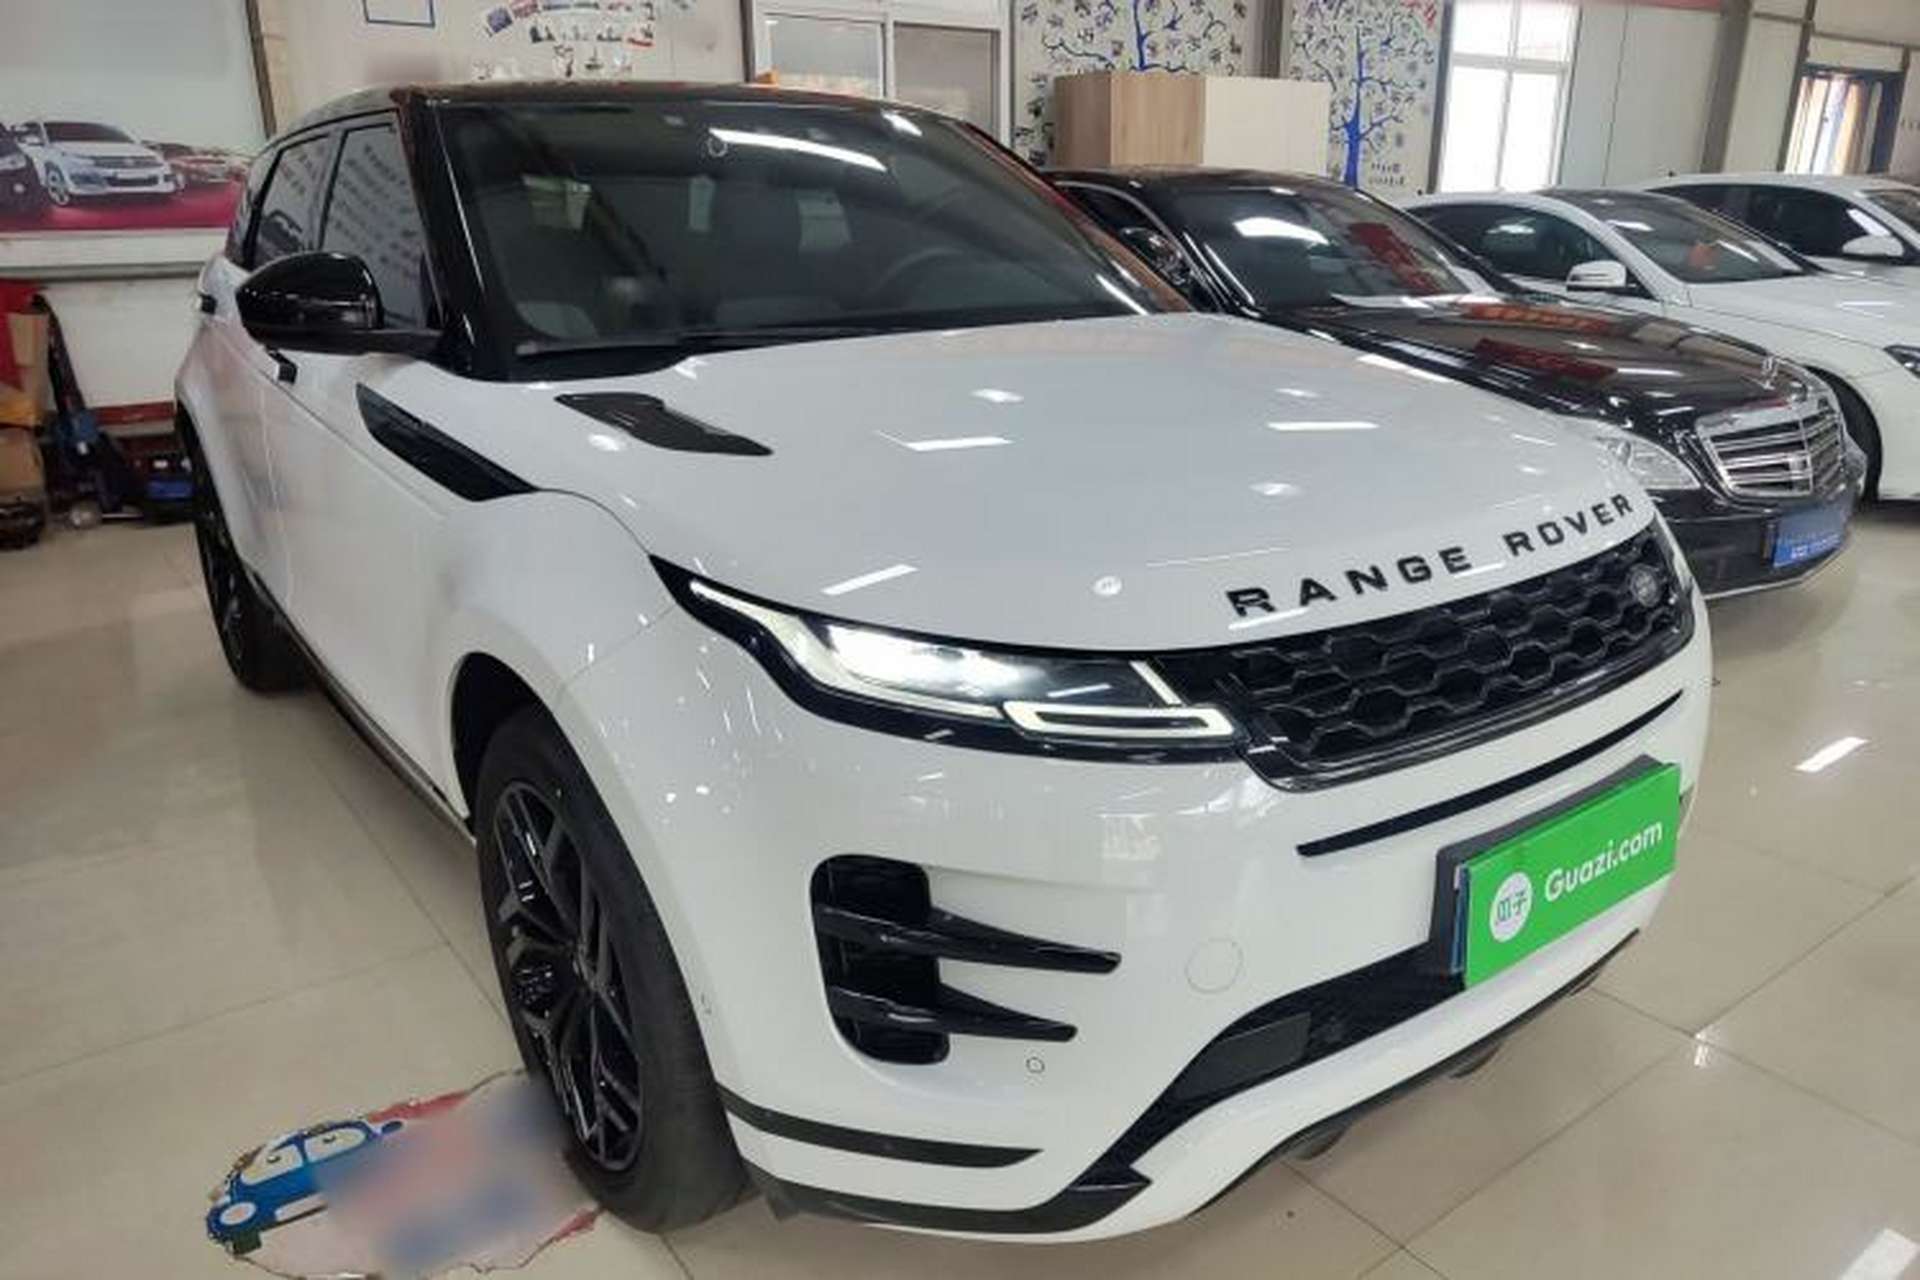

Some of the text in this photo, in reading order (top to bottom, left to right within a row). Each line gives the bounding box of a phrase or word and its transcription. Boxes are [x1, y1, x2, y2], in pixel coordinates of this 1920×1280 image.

[1227, 494, 1632, 617] RANGE ROVER
[1544, 822, 1663, 902] Guazi.com
